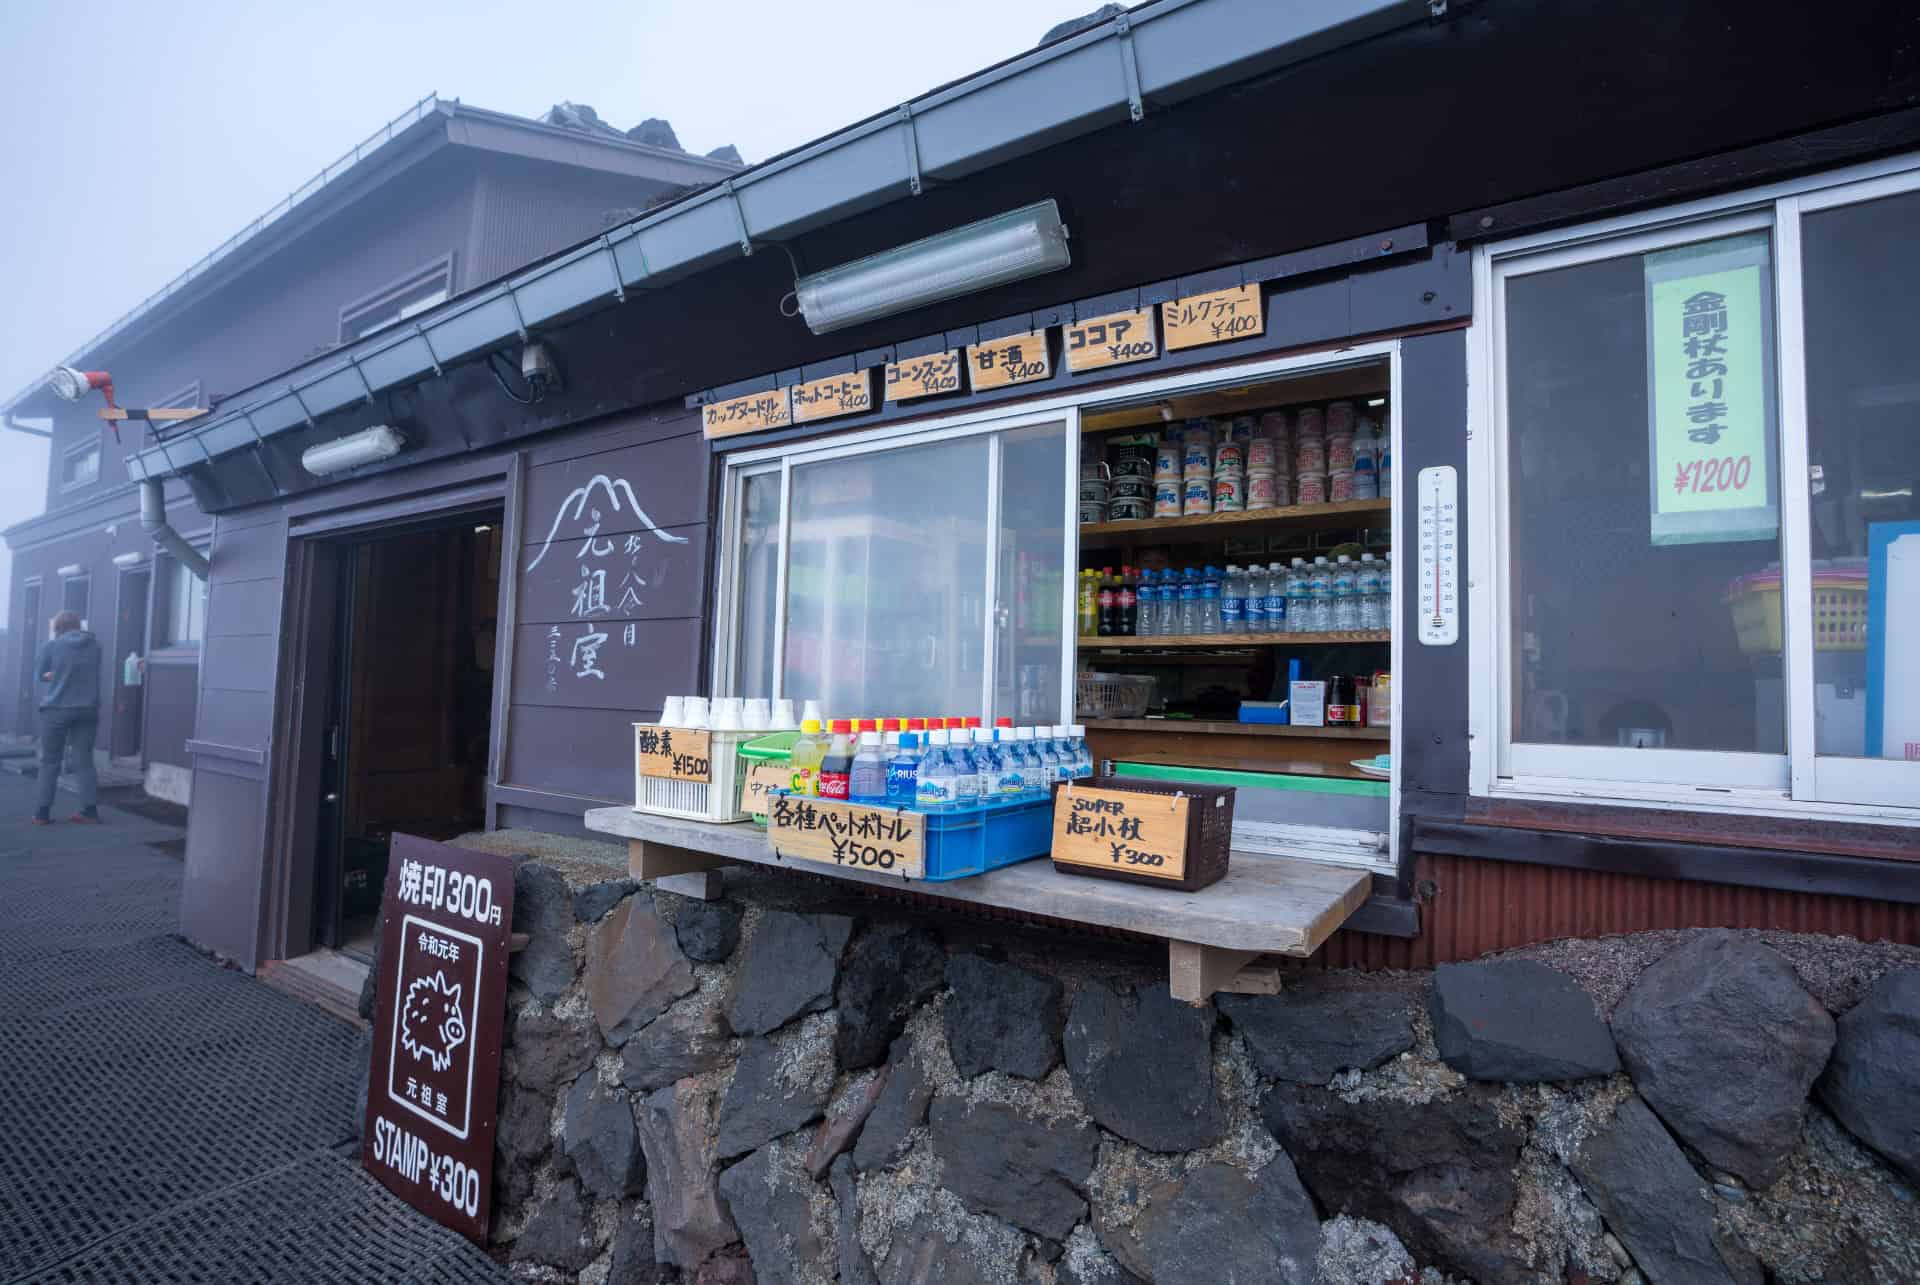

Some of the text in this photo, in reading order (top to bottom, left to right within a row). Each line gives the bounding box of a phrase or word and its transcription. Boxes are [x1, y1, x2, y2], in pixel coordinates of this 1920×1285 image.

[1168, 297, 1250, 327] ミルクティー
[1210, 314, 1256, 338] ¥400
[1070, 320, 1132, 349] ココア
[975, 345, 1023, 369] 甘酒
[1108, 341, 1153, 359] ¥400
[887, 355, 957, 385] コーンスープ
[1006, 361, 1045, 380] ¥400
[1682, 291, 1728, 444] 金剛杖あります
[794, 381, 862, 405] ホットコーヒー
[922, 375, 956, 392] ¥400
[706, 397, 779, 425] カップヌードル
[838, 393, 869, 410] ¥400
[1674, 455, 1751, 494] ¥1200
[640, 728, 672, 758] 酸素
[672, 752, 708, 776] ¥1500
[774, 799, 912, 842] 各種ペットボトル
[1072, 798, 1125, 816] SUPER
[1065, 811, 1145, 841] 超小杖
[418, 931, 460, 963] 令和元年
[406, 1077, 448, 1116] 元祖室
